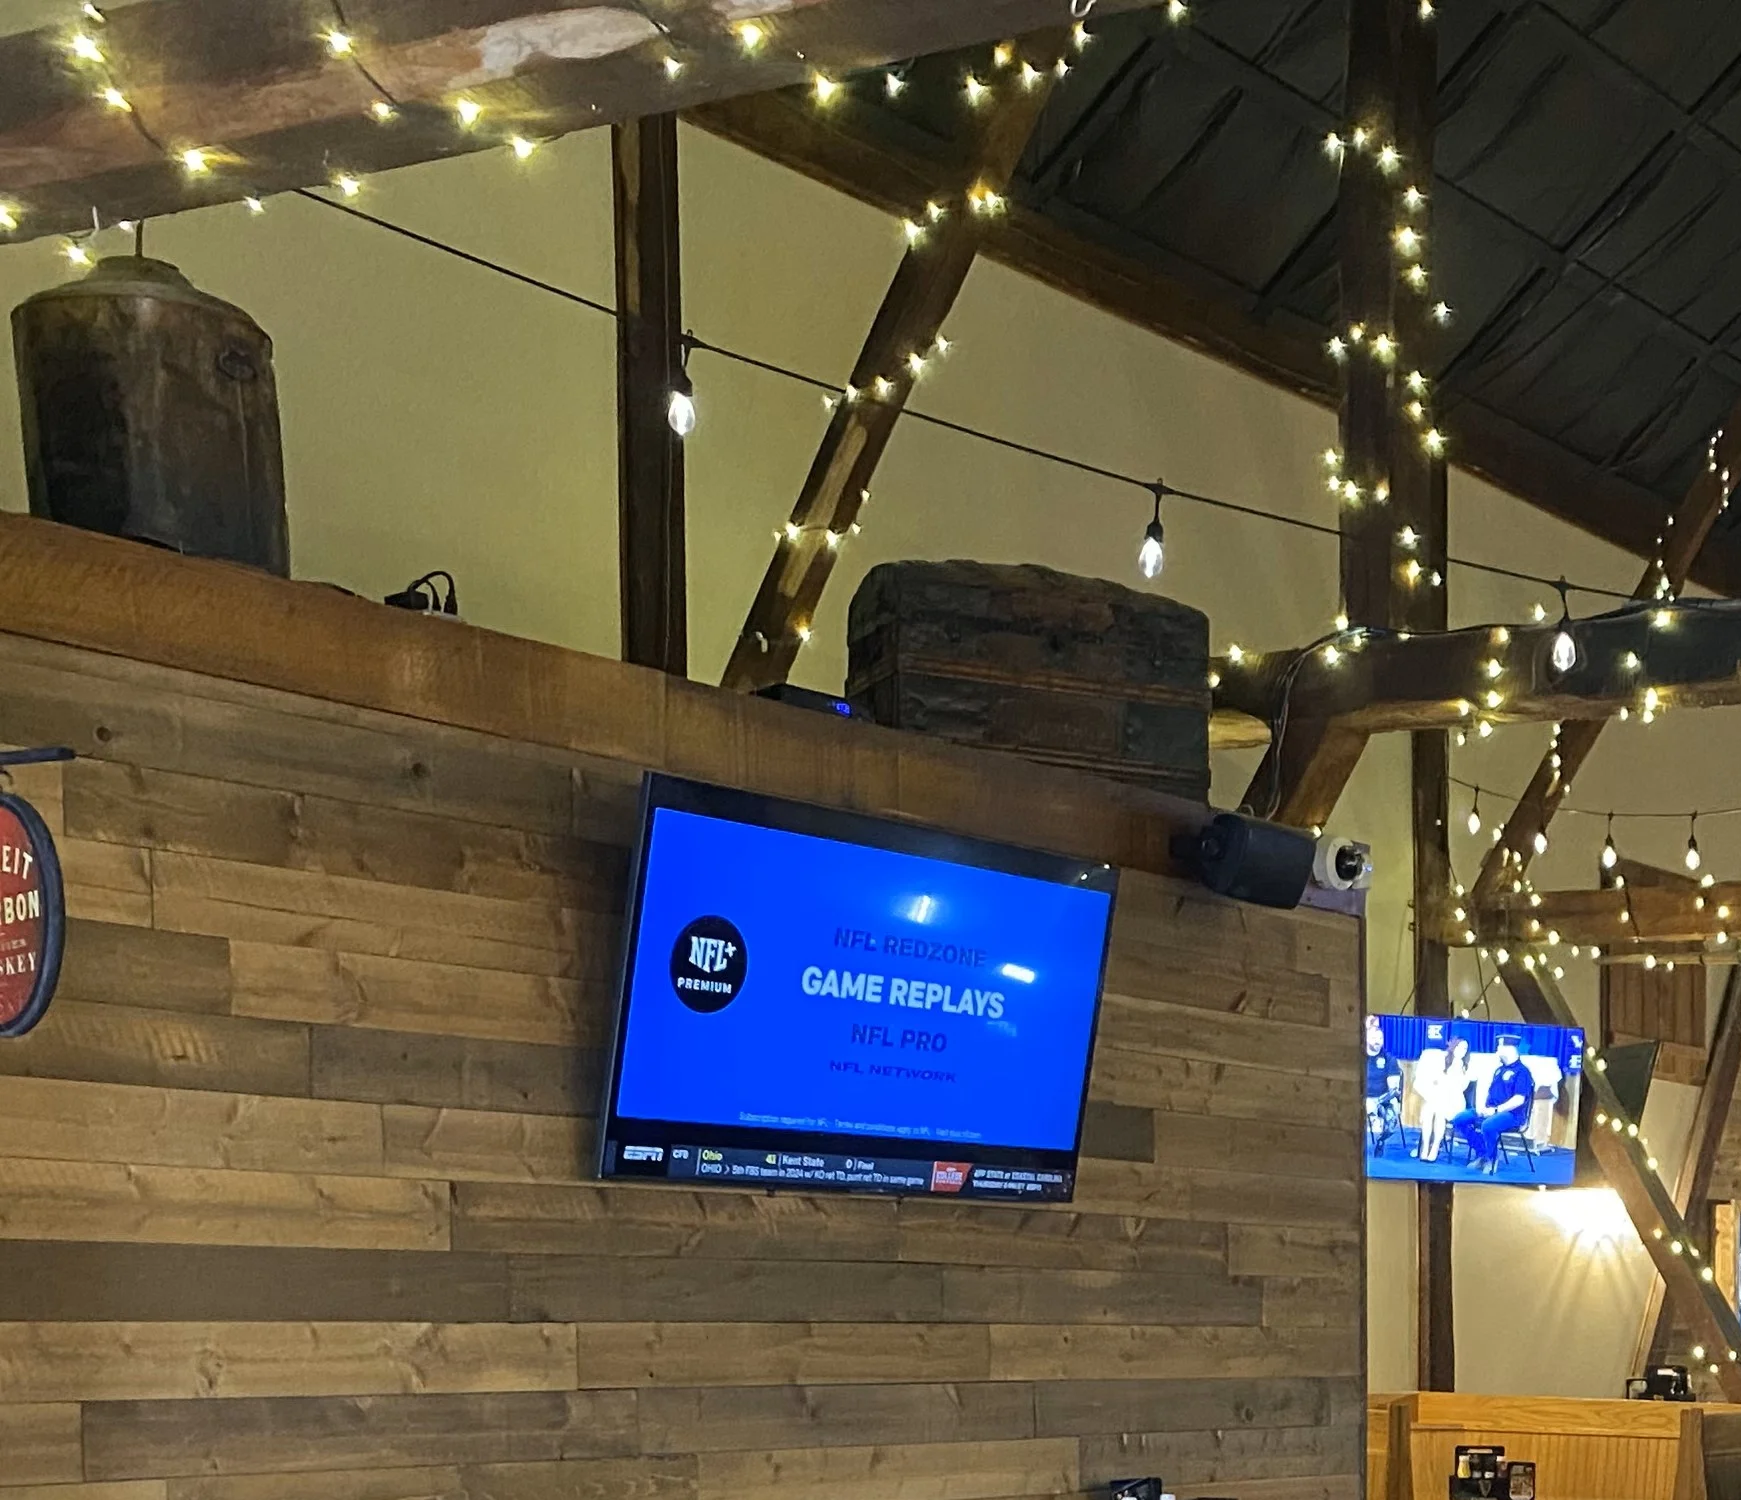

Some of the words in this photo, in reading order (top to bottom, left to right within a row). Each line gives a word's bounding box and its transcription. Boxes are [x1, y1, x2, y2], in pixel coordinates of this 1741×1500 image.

[0, 889, 40, 925] BON
[834, 927, 877, 953] NFL
[883, 933, 988, 969] REDZONE
[676, 976, 733, 994] PREMIUM
[802, 965, 884, 1004] GAME
[889, 980, 1005, 1020] REPLAYS
[850, 1022, 895, 1048] NFL
[901, 1027, 947, 1053] PRO
[828, 1059, 864, 1075] NFL
[868, 1063, 956, 1084] NETWORK
[702, 1149, 723, 1161] Ohio
[782, 1155, 801, 1166] Kent
[802, 1156, 825, 1167] State
[845, 1158, 853, 1169] 0
[701, 1162, 722, 1174] OHIO
